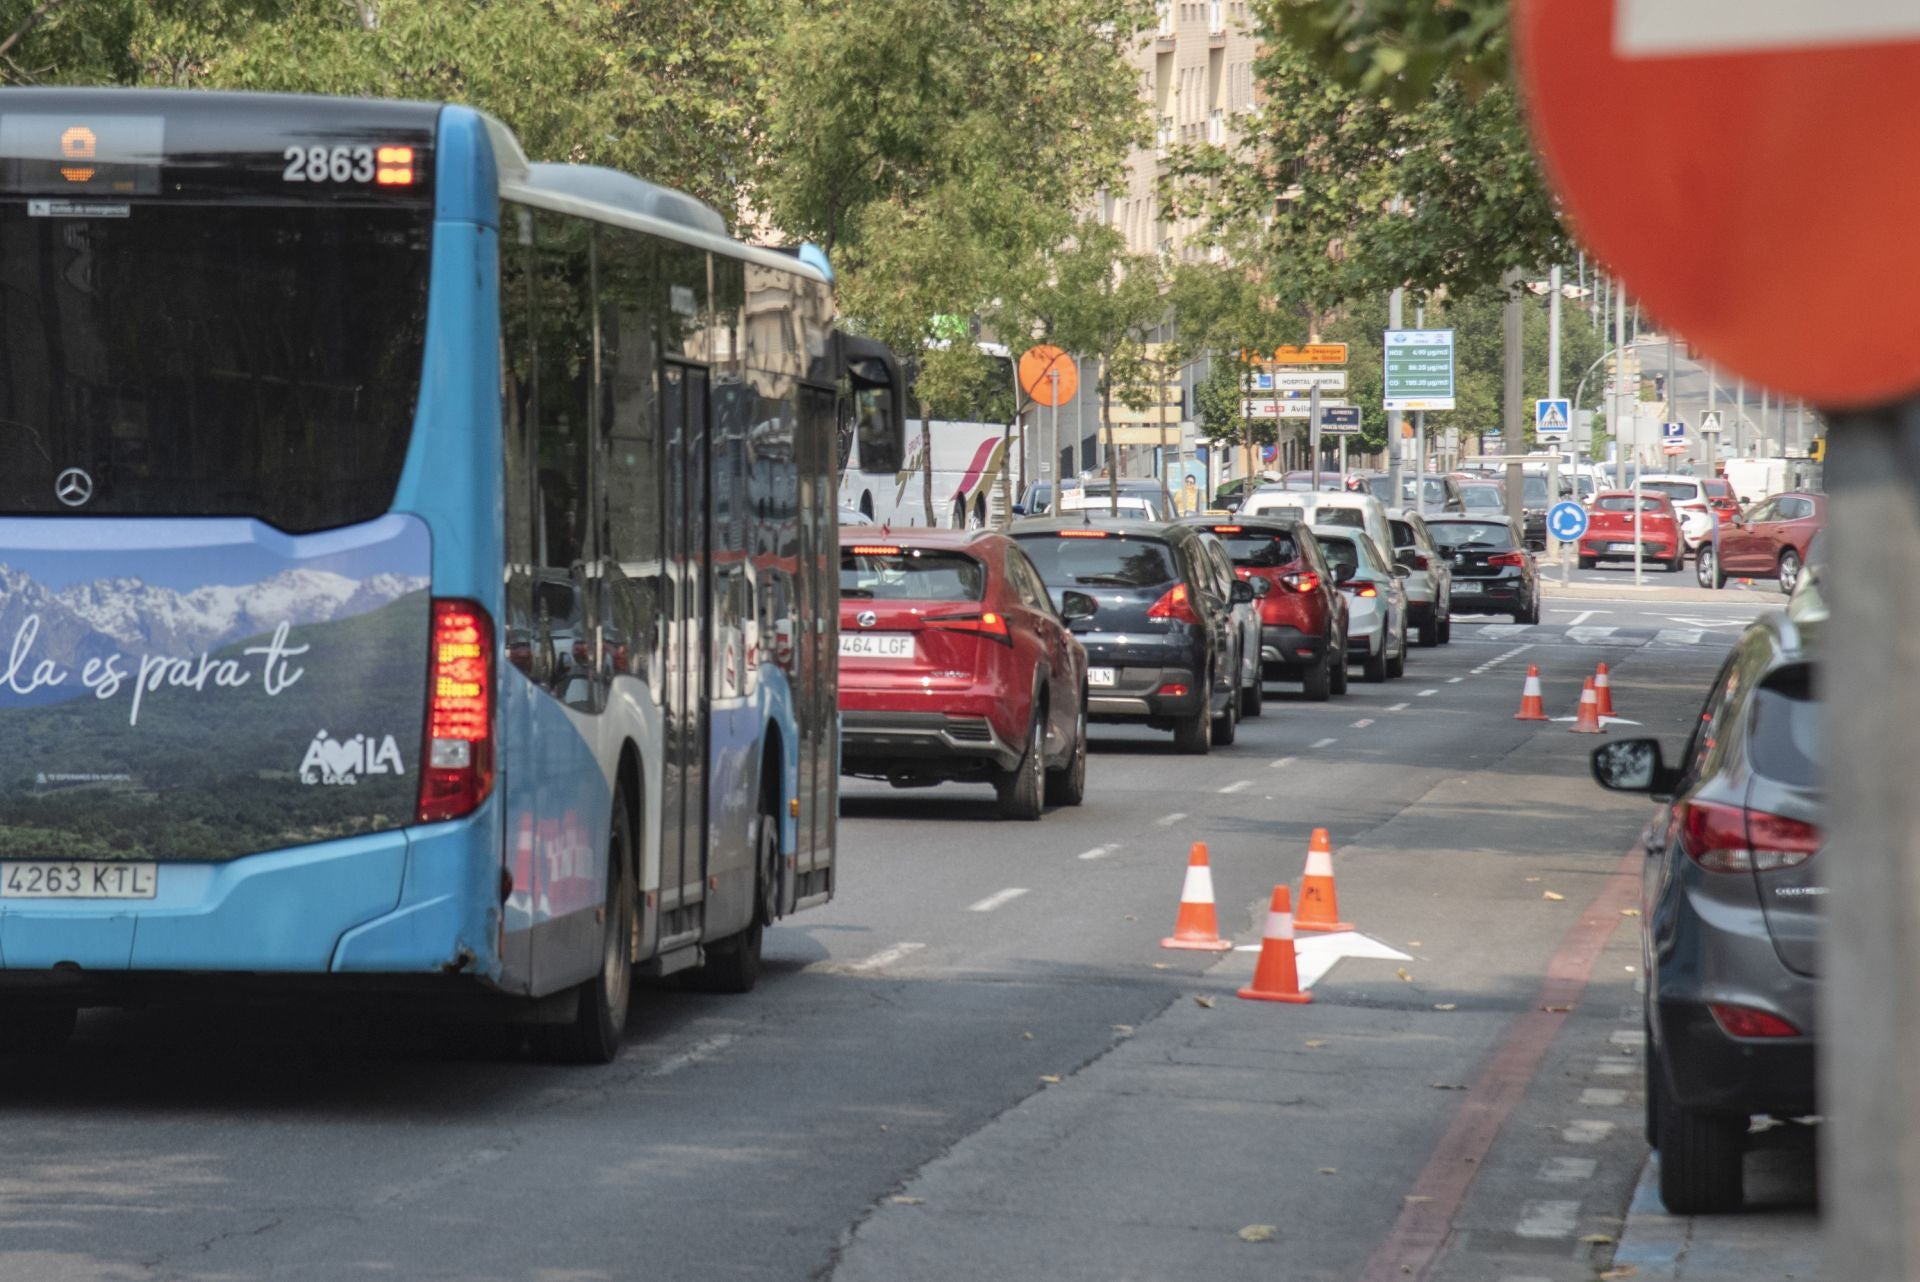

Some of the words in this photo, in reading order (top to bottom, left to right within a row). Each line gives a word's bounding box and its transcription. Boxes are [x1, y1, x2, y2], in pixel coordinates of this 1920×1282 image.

[282, 146, 375, 182] 2863
[1669, 423, 1681, 436] P
[839, 637, 873, 653] 464
[877, 638, 911, 655] LGF
[0, 613, 68, 694] la
[81, 653, 128, 699] es
[129, 651, 251, 727] para
[243, 619, 310, 696] ti
[7, 866, 82, 893] 4263
[92, 866, 148, 893] KTL
